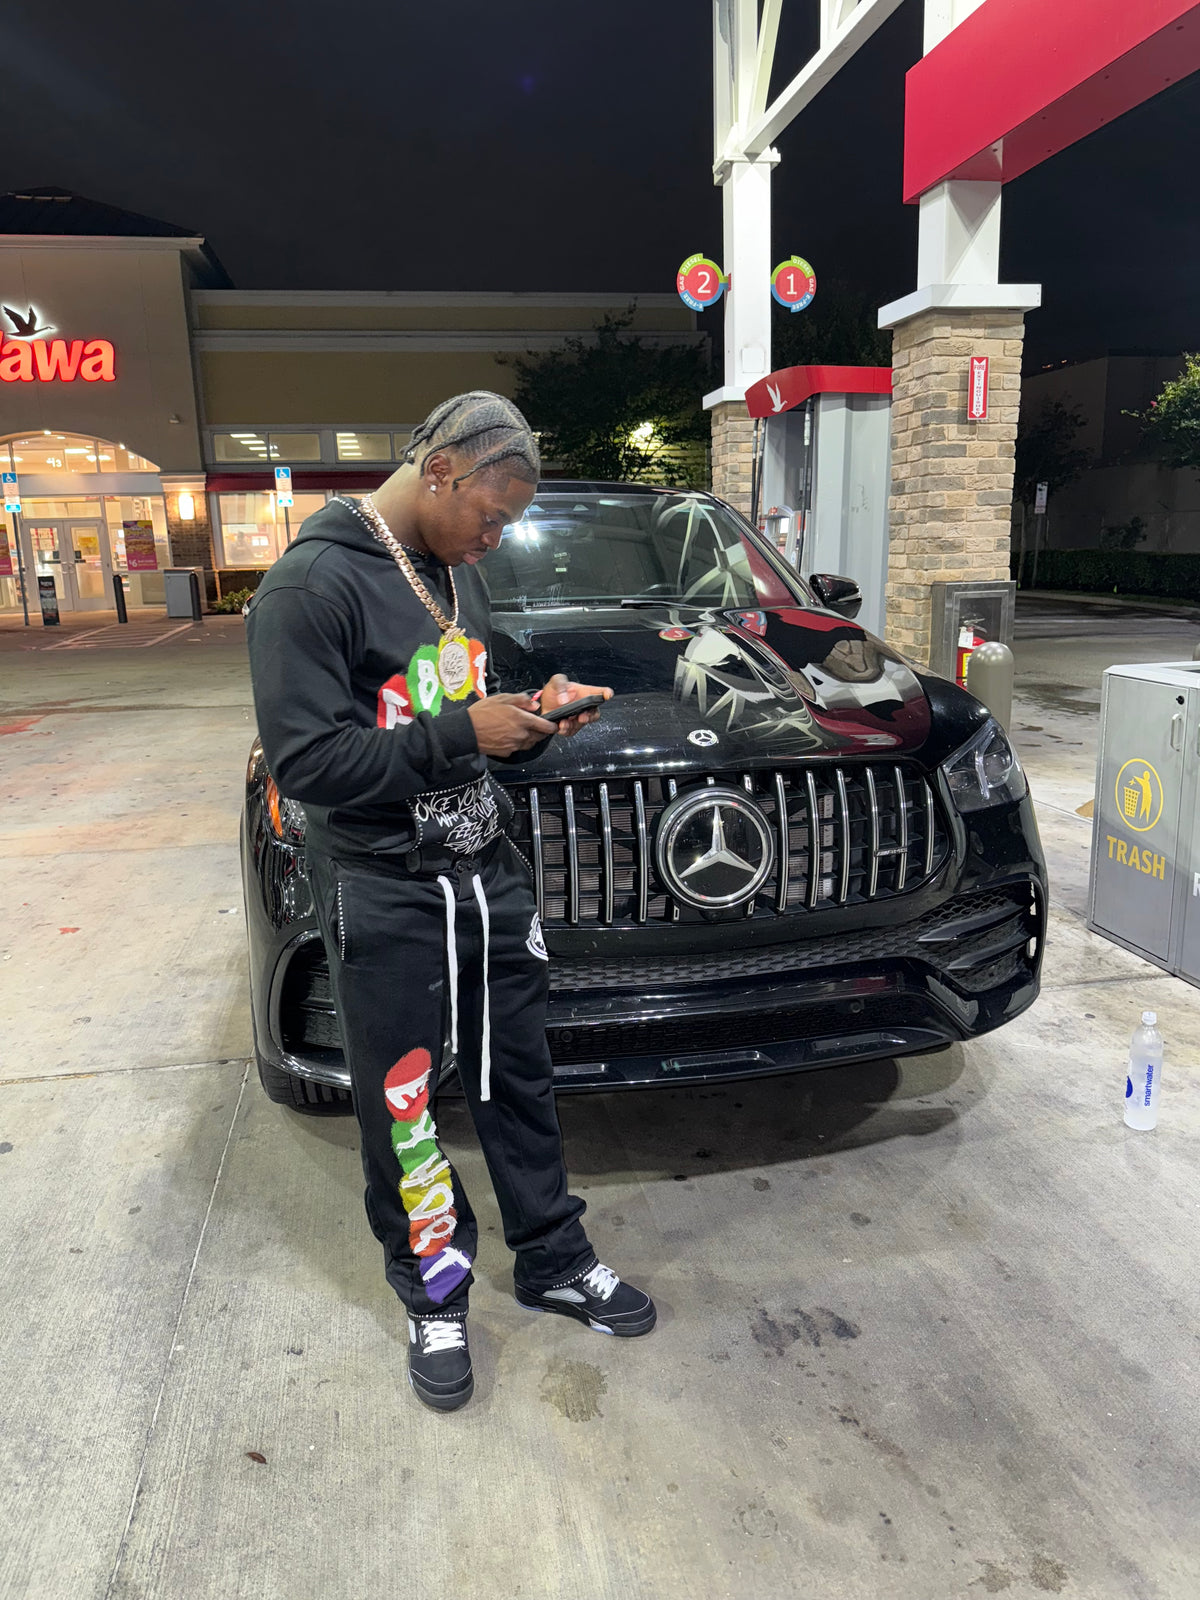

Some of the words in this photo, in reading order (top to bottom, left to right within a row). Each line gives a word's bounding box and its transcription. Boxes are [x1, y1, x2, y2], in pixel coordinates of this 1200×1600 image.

[681, 256, 702, 273] DIESEL
[792, 258, 812, 275] DIESEL
[697, 271, 711, 294] 2
[786, 273, 797, 295] 1
[0, 330, 117, 383] awa
[1106, 834, 1166, 880] TRASH
[1144, 1064, 1154, 1107] smartwater
